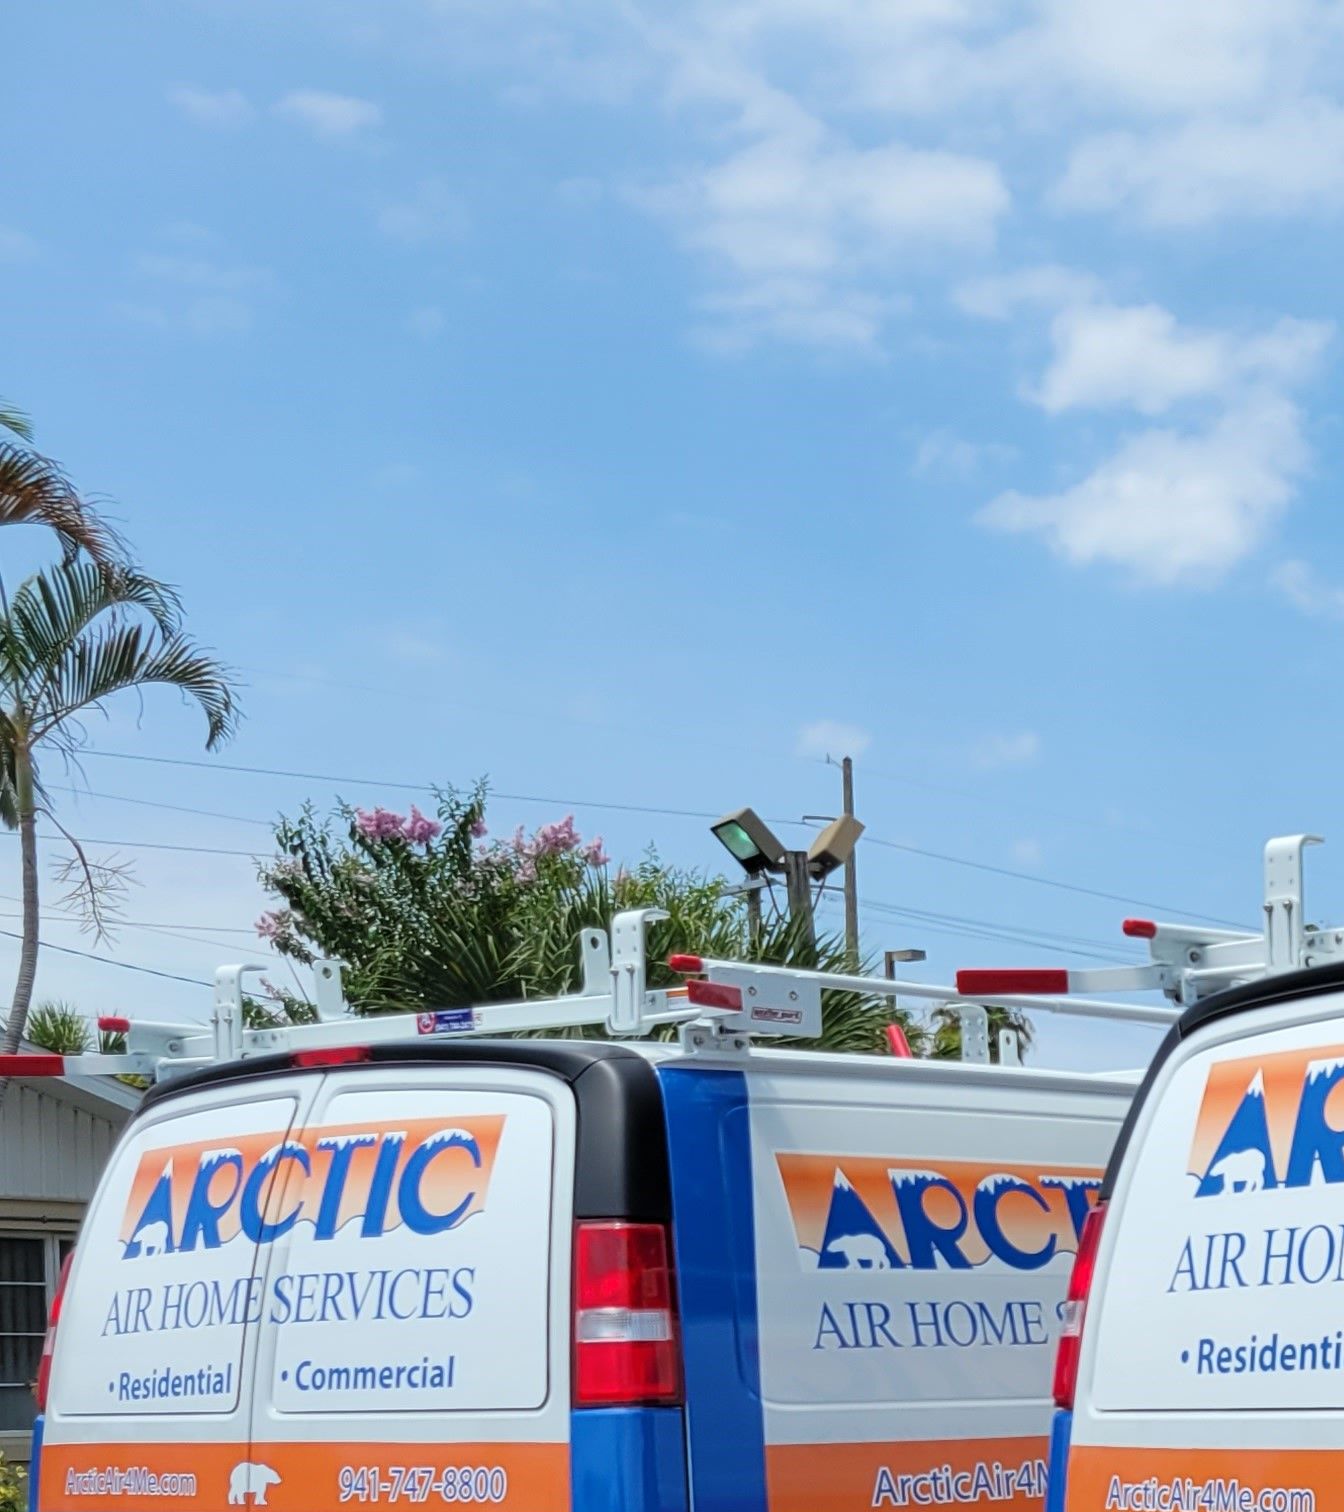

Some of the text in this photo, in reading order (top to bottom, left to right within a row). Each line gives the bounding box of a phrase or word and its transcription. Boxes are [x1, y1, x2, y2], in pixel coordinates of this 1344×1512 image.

[121, 1129, 481, 1259] ARCTIC
[1168, 1231, 1249, 1294] AIR
[101, 1267, 475, 1337] AIR HOME SERVICES
[813, 1303, 902, 1350] AIR
[906, 1301, 1049, 1348] HOME
[119, 1364, 232, 1401] Residential
[295, 1356, 455, 1391] Commercial
[64, 1467, 196, 1497] ArcticAir4Me.com
[338, 1467, 507, 1503] 941-747-8800
